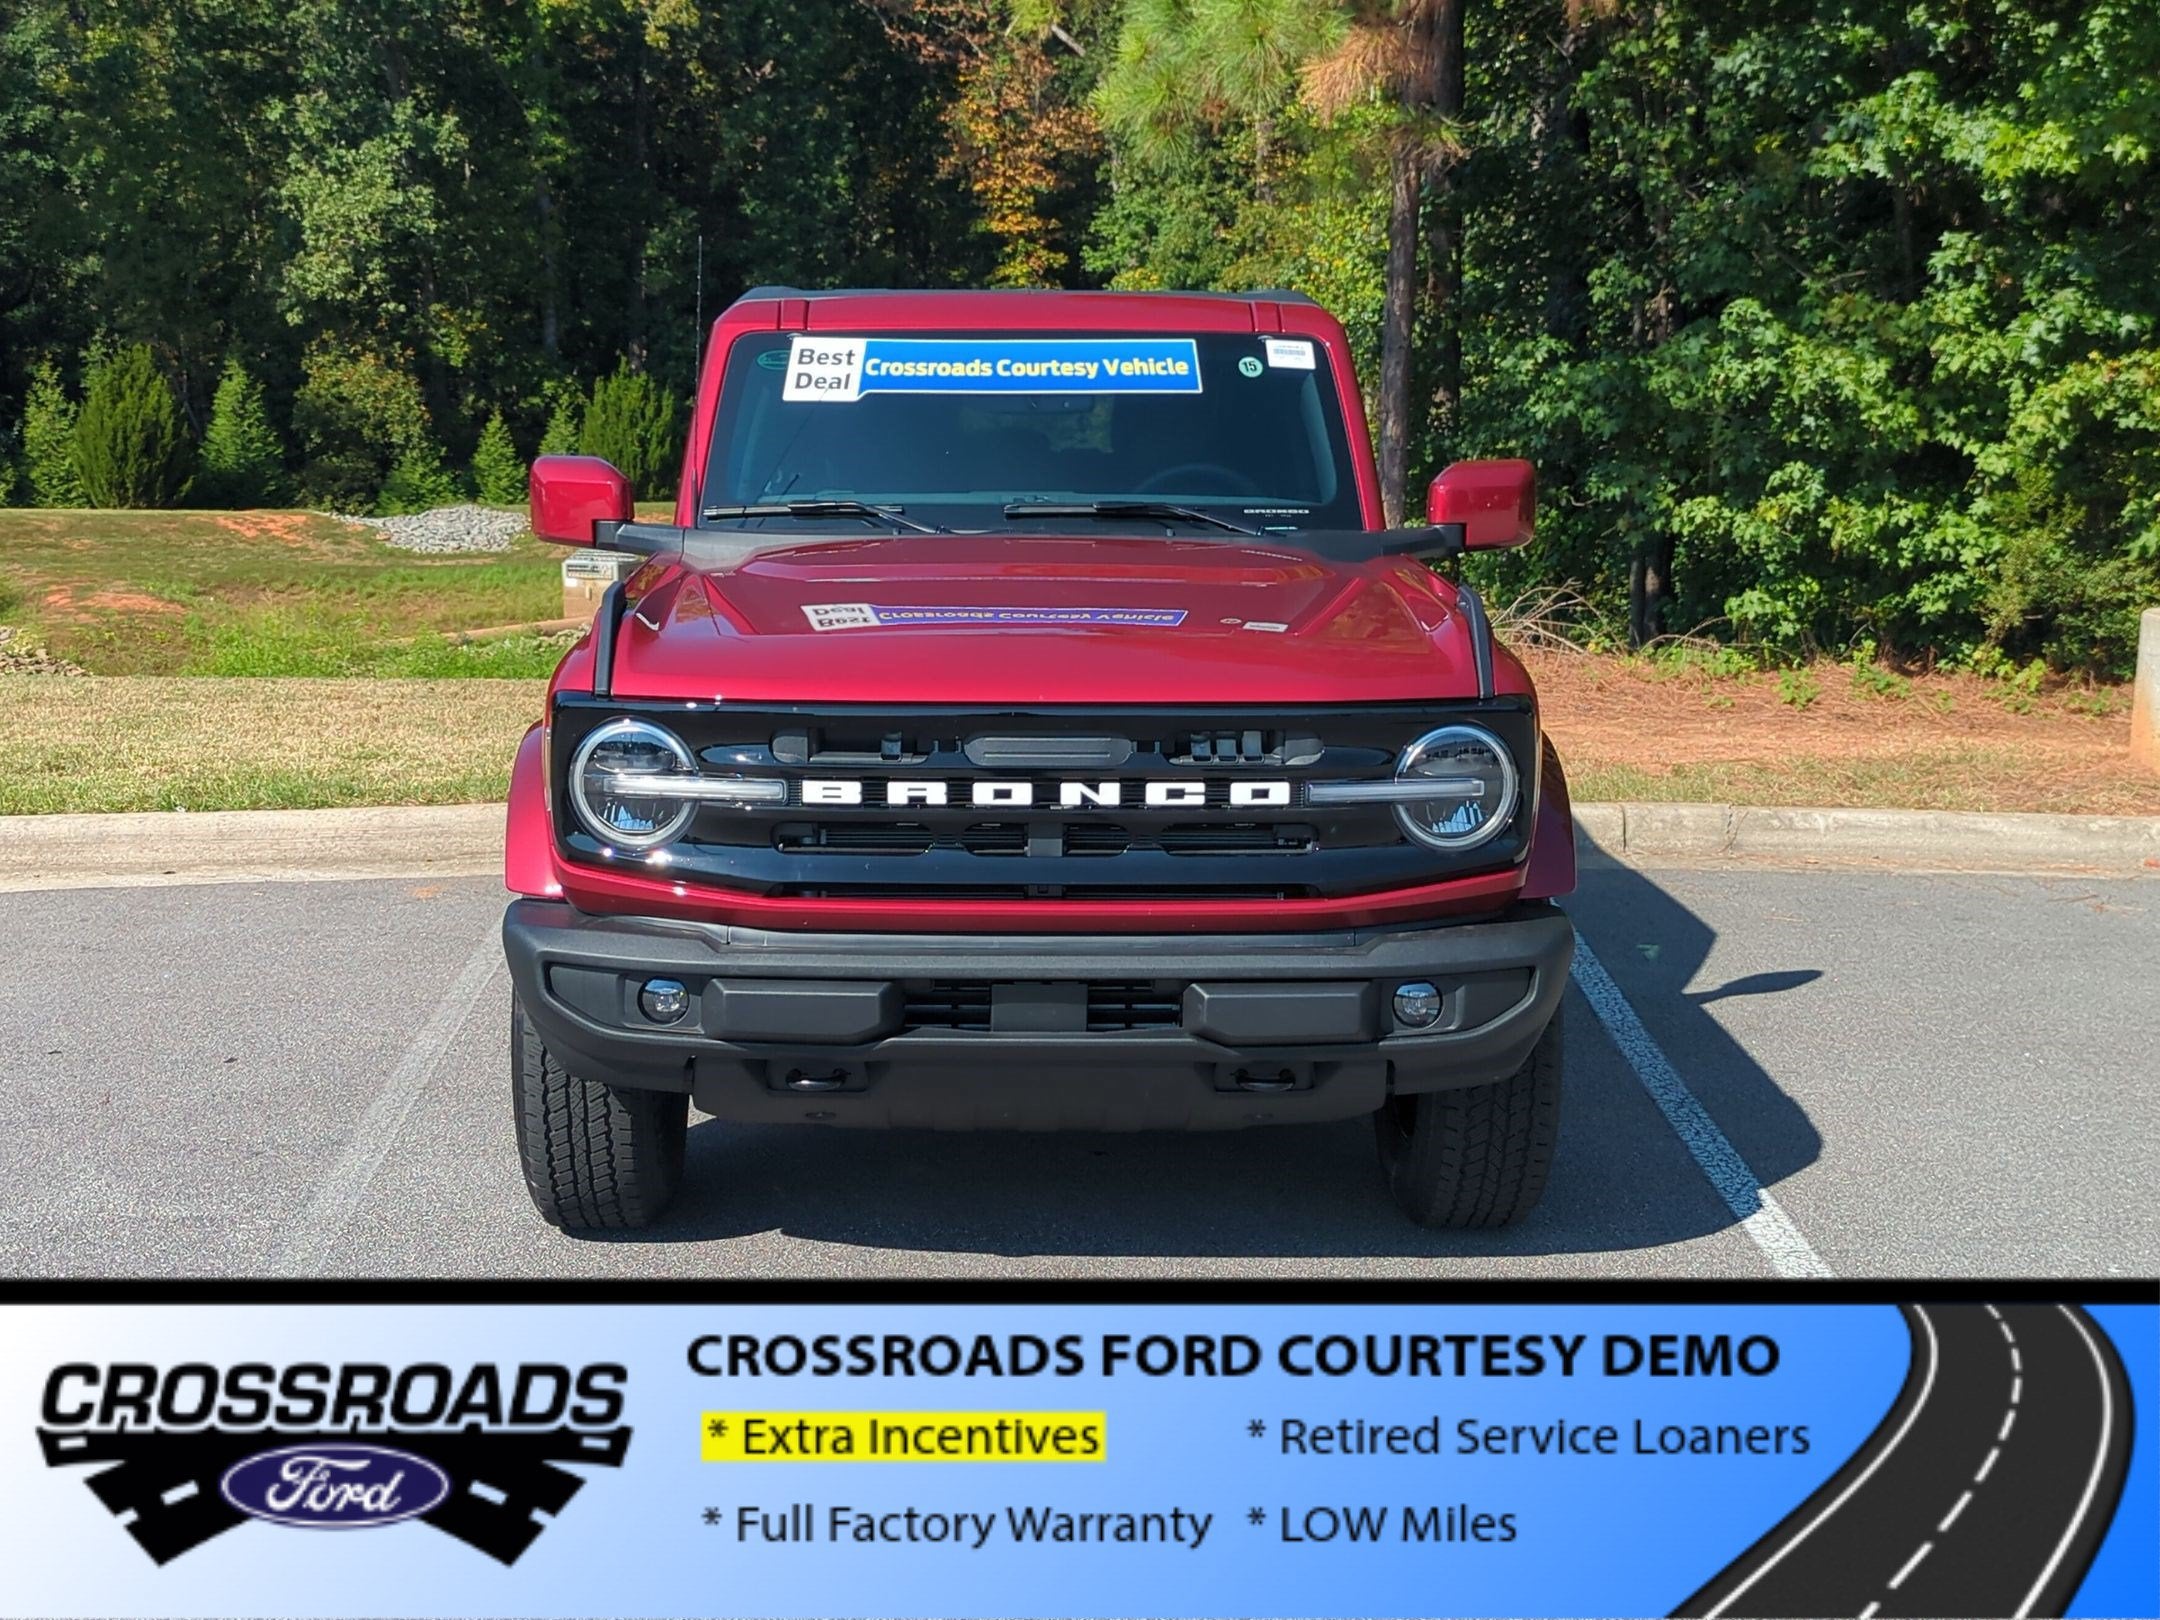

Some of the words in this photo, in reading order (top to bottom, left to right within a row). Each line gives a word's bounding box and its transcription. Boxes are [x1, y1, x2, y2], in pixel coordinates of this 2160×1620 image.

[797, 348, 855, 366] Best
[1242, 360, 1257, 372] 15
[865, 358, 993, 376] Crossroads
[995, 358, 1099, 379] Courtesy
[1102, 357, 1190, 376] Vehicle
[794, 372, 851, 390] Deal
[802, 781, 1291, 806] BRONCO
